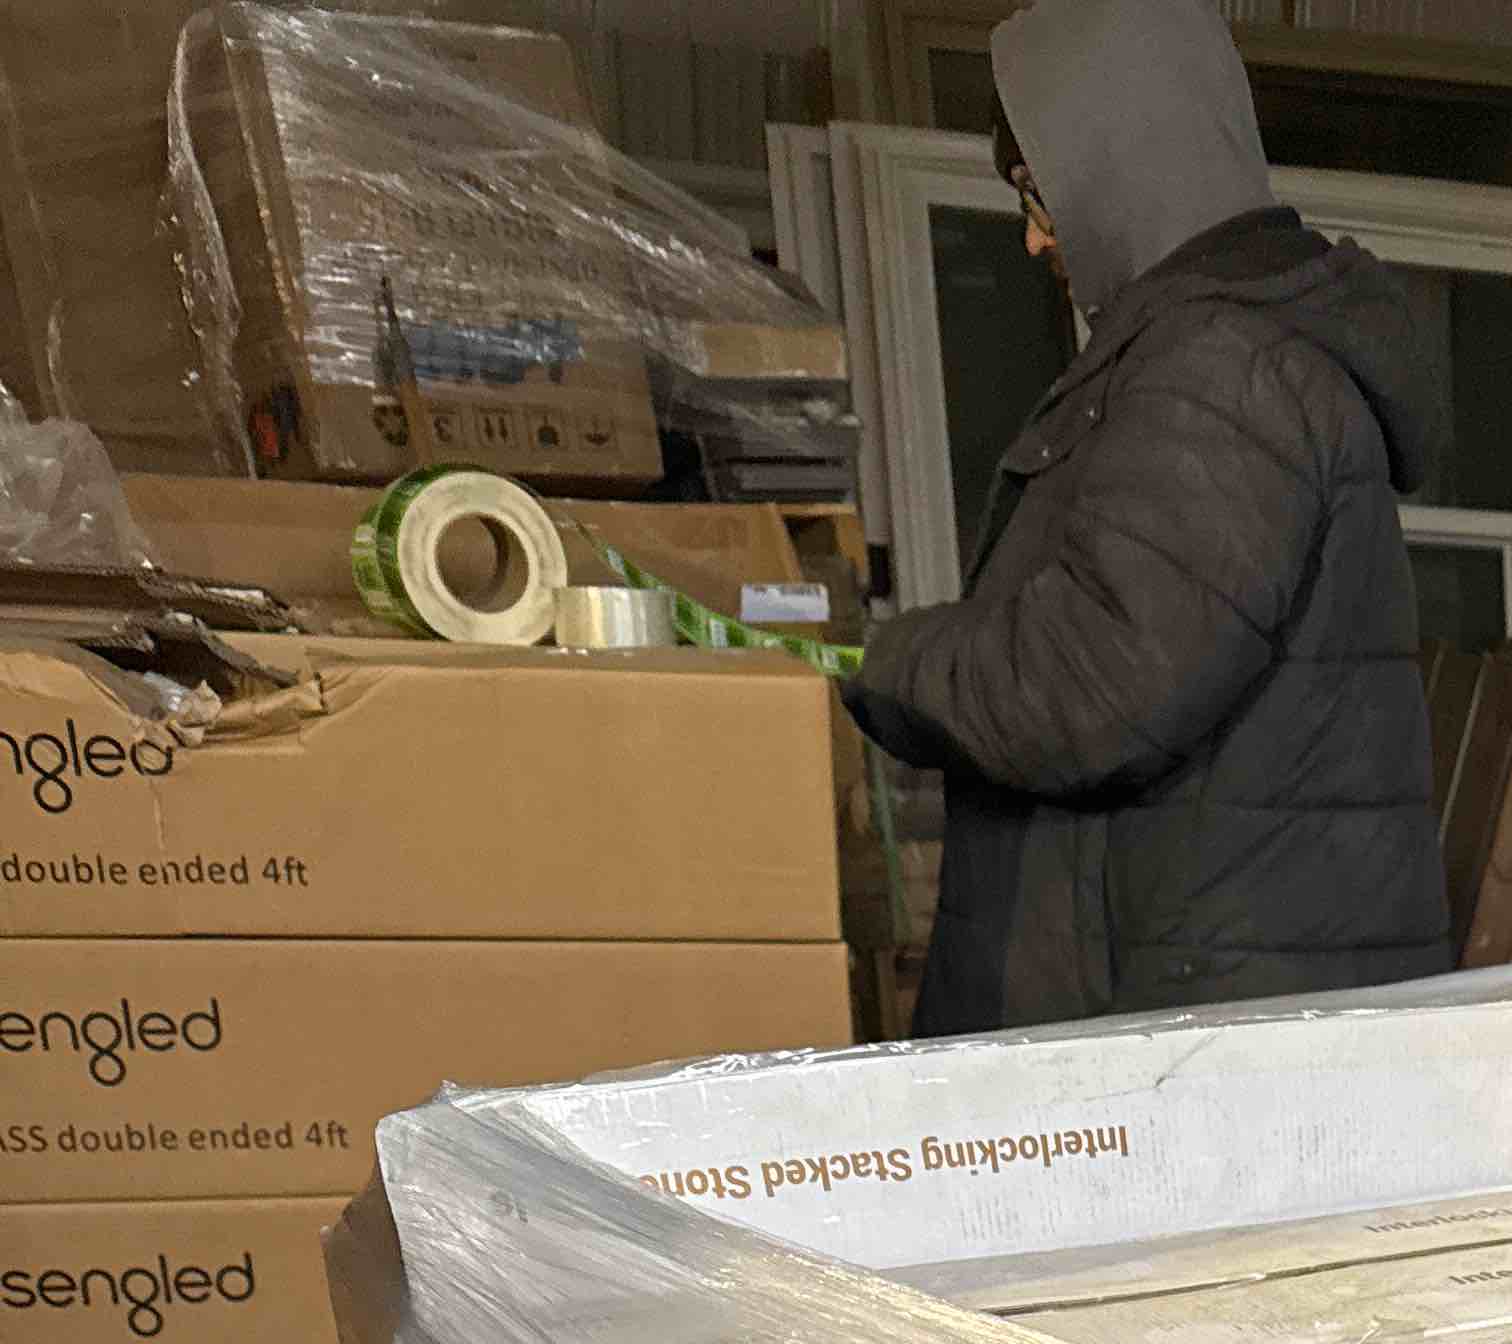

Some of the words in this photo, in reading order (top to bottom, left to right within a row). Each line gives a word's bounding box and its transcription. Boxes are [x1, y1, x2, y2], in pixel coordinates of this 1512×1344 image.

[1, 853, 127, 885] double
[139, 856, 250, 886] ended
[262, 855, 309, 887] 4ft
[57, 1123, 180, 1153] double
[188, 1121, 295, 1151] ended
[304, 1120, 350, 1150] 4ft
[922, 1125, 1129, 1177] Interlocking
[765, 1147, 912, 1198] Stacked
[1, 1251, 256, 1338] sengled
